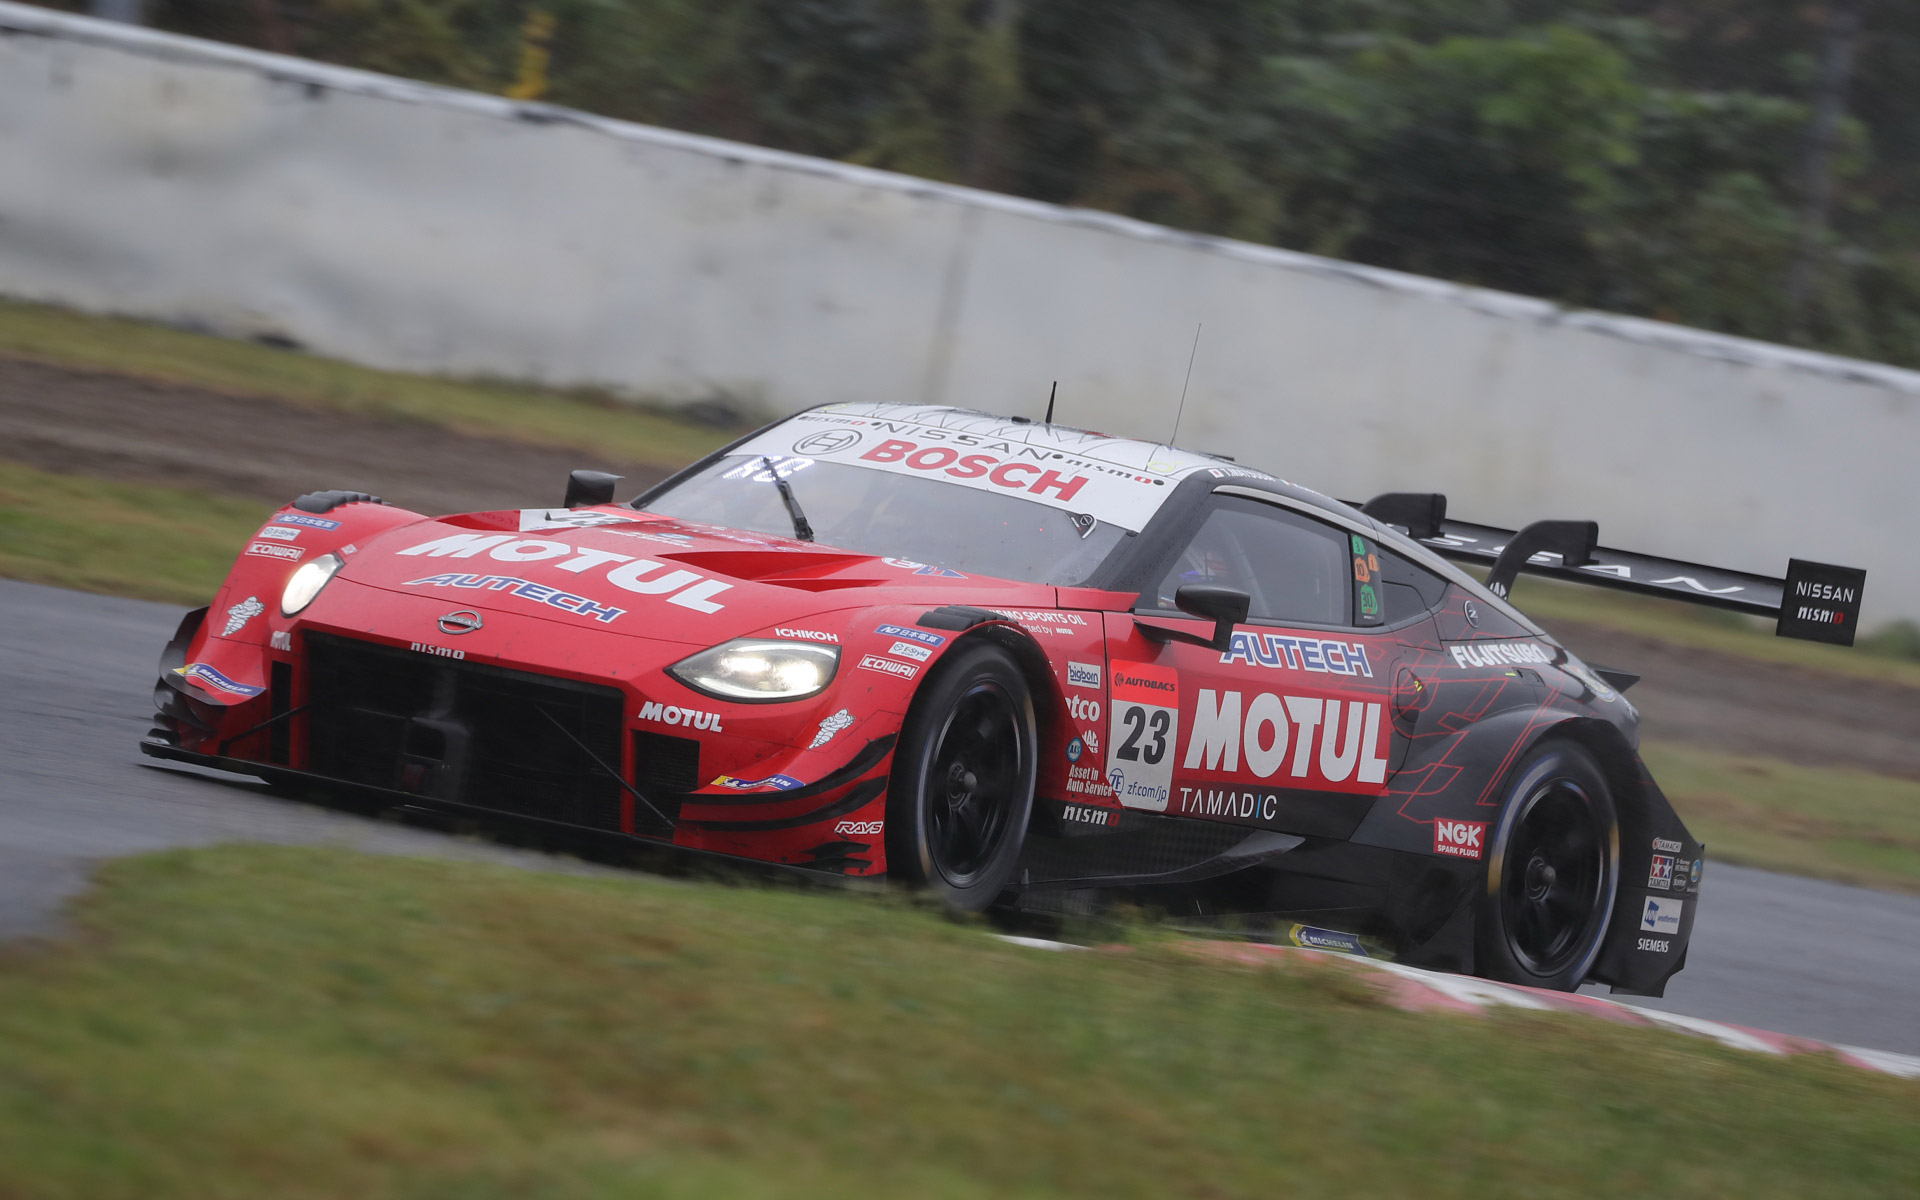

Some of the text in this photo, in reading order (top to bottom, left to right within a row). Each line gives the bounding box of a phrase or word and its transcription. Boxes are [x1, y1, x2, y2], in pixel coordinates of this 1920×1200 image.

[874, 423, 1152, 484] NISSAN nismo
[859, 438, 1089, 502] BOSCH
[394, 533, 735, 615] MOTUL
[401, 573, 628, 624] AUTECH
[1796, 581, 1854, 603] NISSAN
[1022, 612, 1068, 625] SPORTS
[1067, 614, 1088, 626] OIL
[1797, 606, 1844, 625] nismo
[774, 627, 839, 643] ICHIKOH
[1042, 625, 1053, 636] by
[410, 641, 466, 660] nismo
[1219, 631, 1373, 678] AUTECH
[1450, 644, 1550, 669] FUJITSUBO
[1068, 664, 1099, 681] bigborn
[1125, 676, 1176, 692] AUTOBACS
[638, 701, 723, 732] MOTUL
[1116, 706, 1170, 765] 23
[1183, 689, 1387, 784] MOTUL
[1069, 764, 1099, 780] Asset in
[1066, 778, 1112, 796] Auto Service
[1128, 782, 1167, 802] zf.com/jp
[1180, 787, 1277, 820] TAMADIC
[1063, 805, 1120, 827] nismo
[835, 821, 883, 834] RAYS
[1438, 820, 1481, 848] NGK
[1437, 844, 1479, 858] SPARK PLUGS
[1309, 936, 1354, 949] MICHELIN
[1637, 938, 1670, 953] SIEMENS
